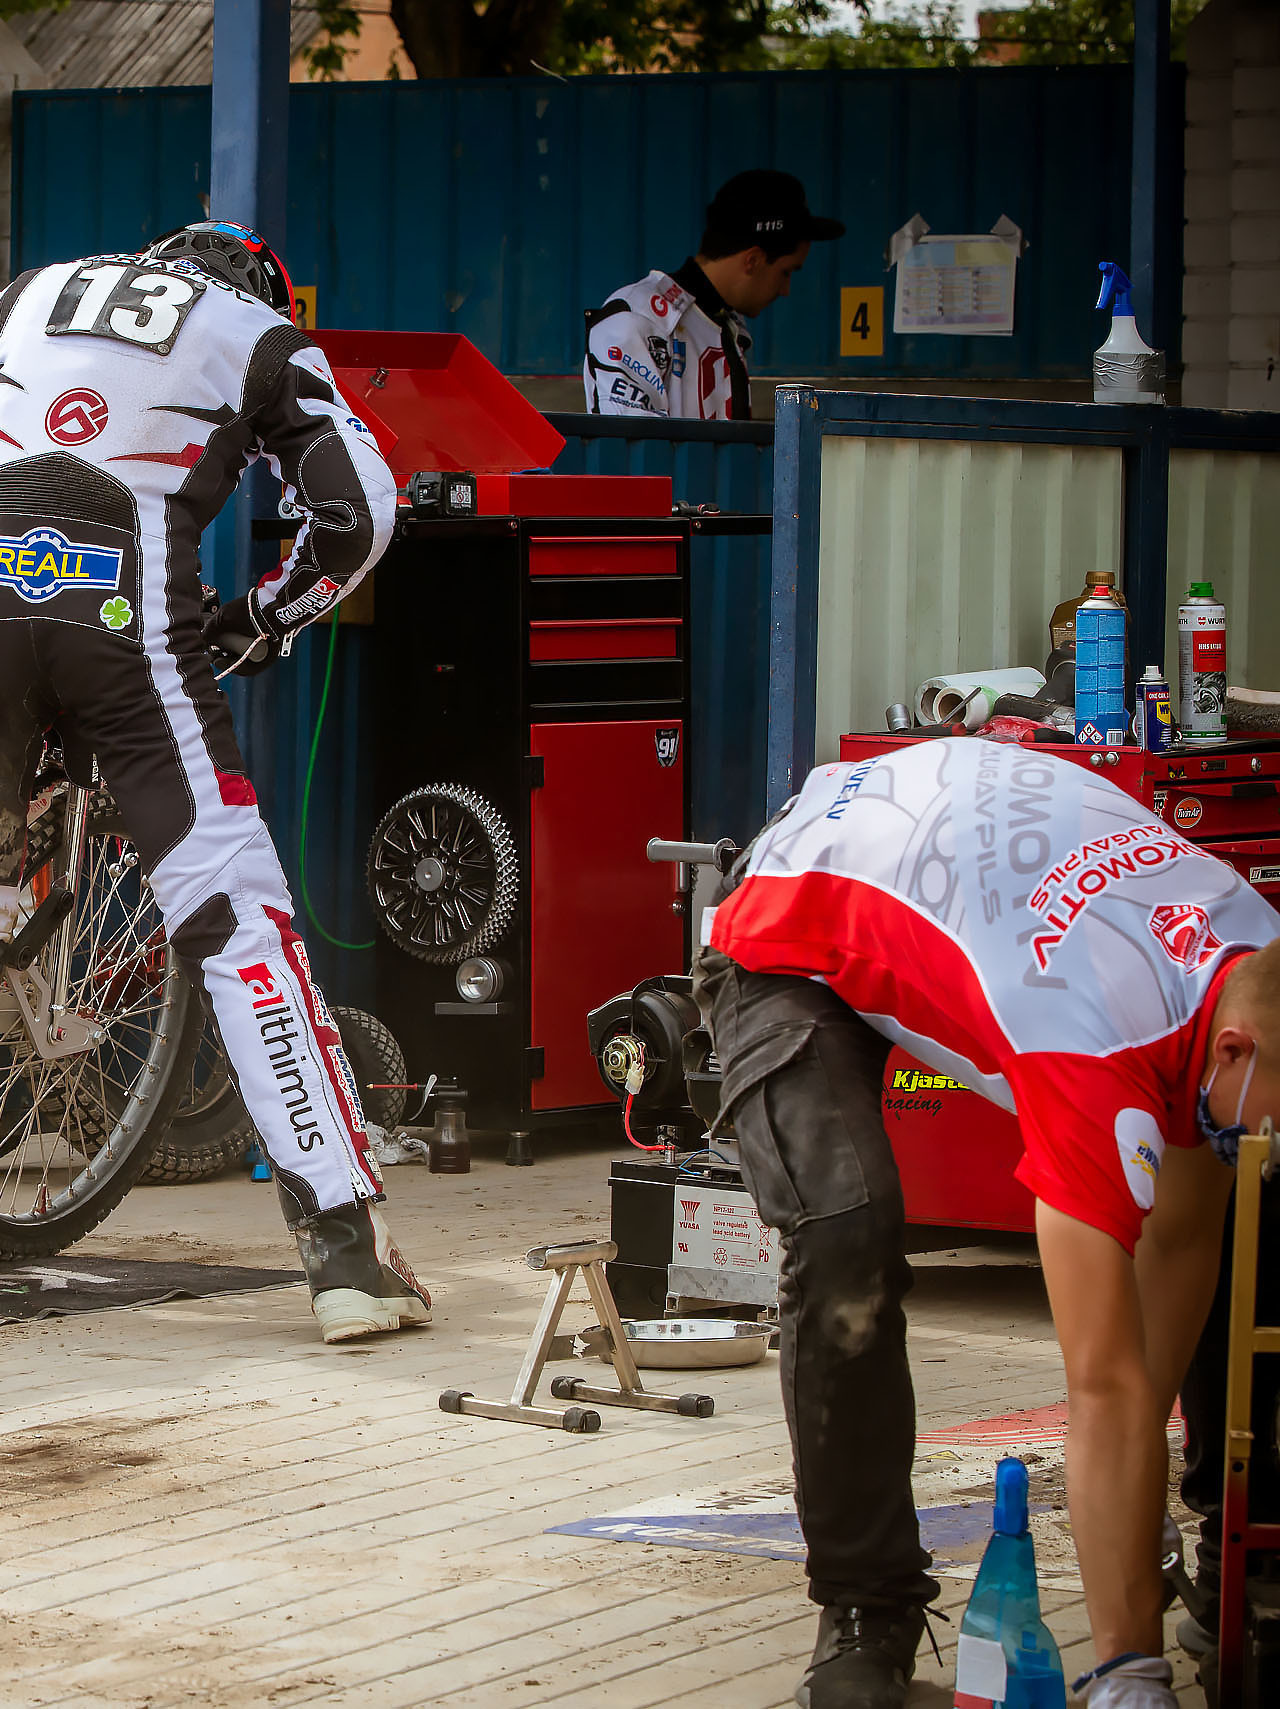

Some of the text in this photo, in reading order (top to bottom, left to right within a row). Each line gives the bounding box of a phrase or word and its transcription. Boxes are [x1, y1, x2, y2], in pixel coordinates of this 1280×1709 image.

[66, 264, 195, 344] 13
[850, 302, 871, 340] 4
[658, 738, 676, 758] 91
[243, 972, 325, 1153] althimus
[679, 1221, 700, 1230] YUASA
[712, 1228, 723, 1236] lead
[734, 1231, 751, 1239] battery
[726, 1221, 749, 1229] regulated
[758, 1248, 770, 1263] Pb
